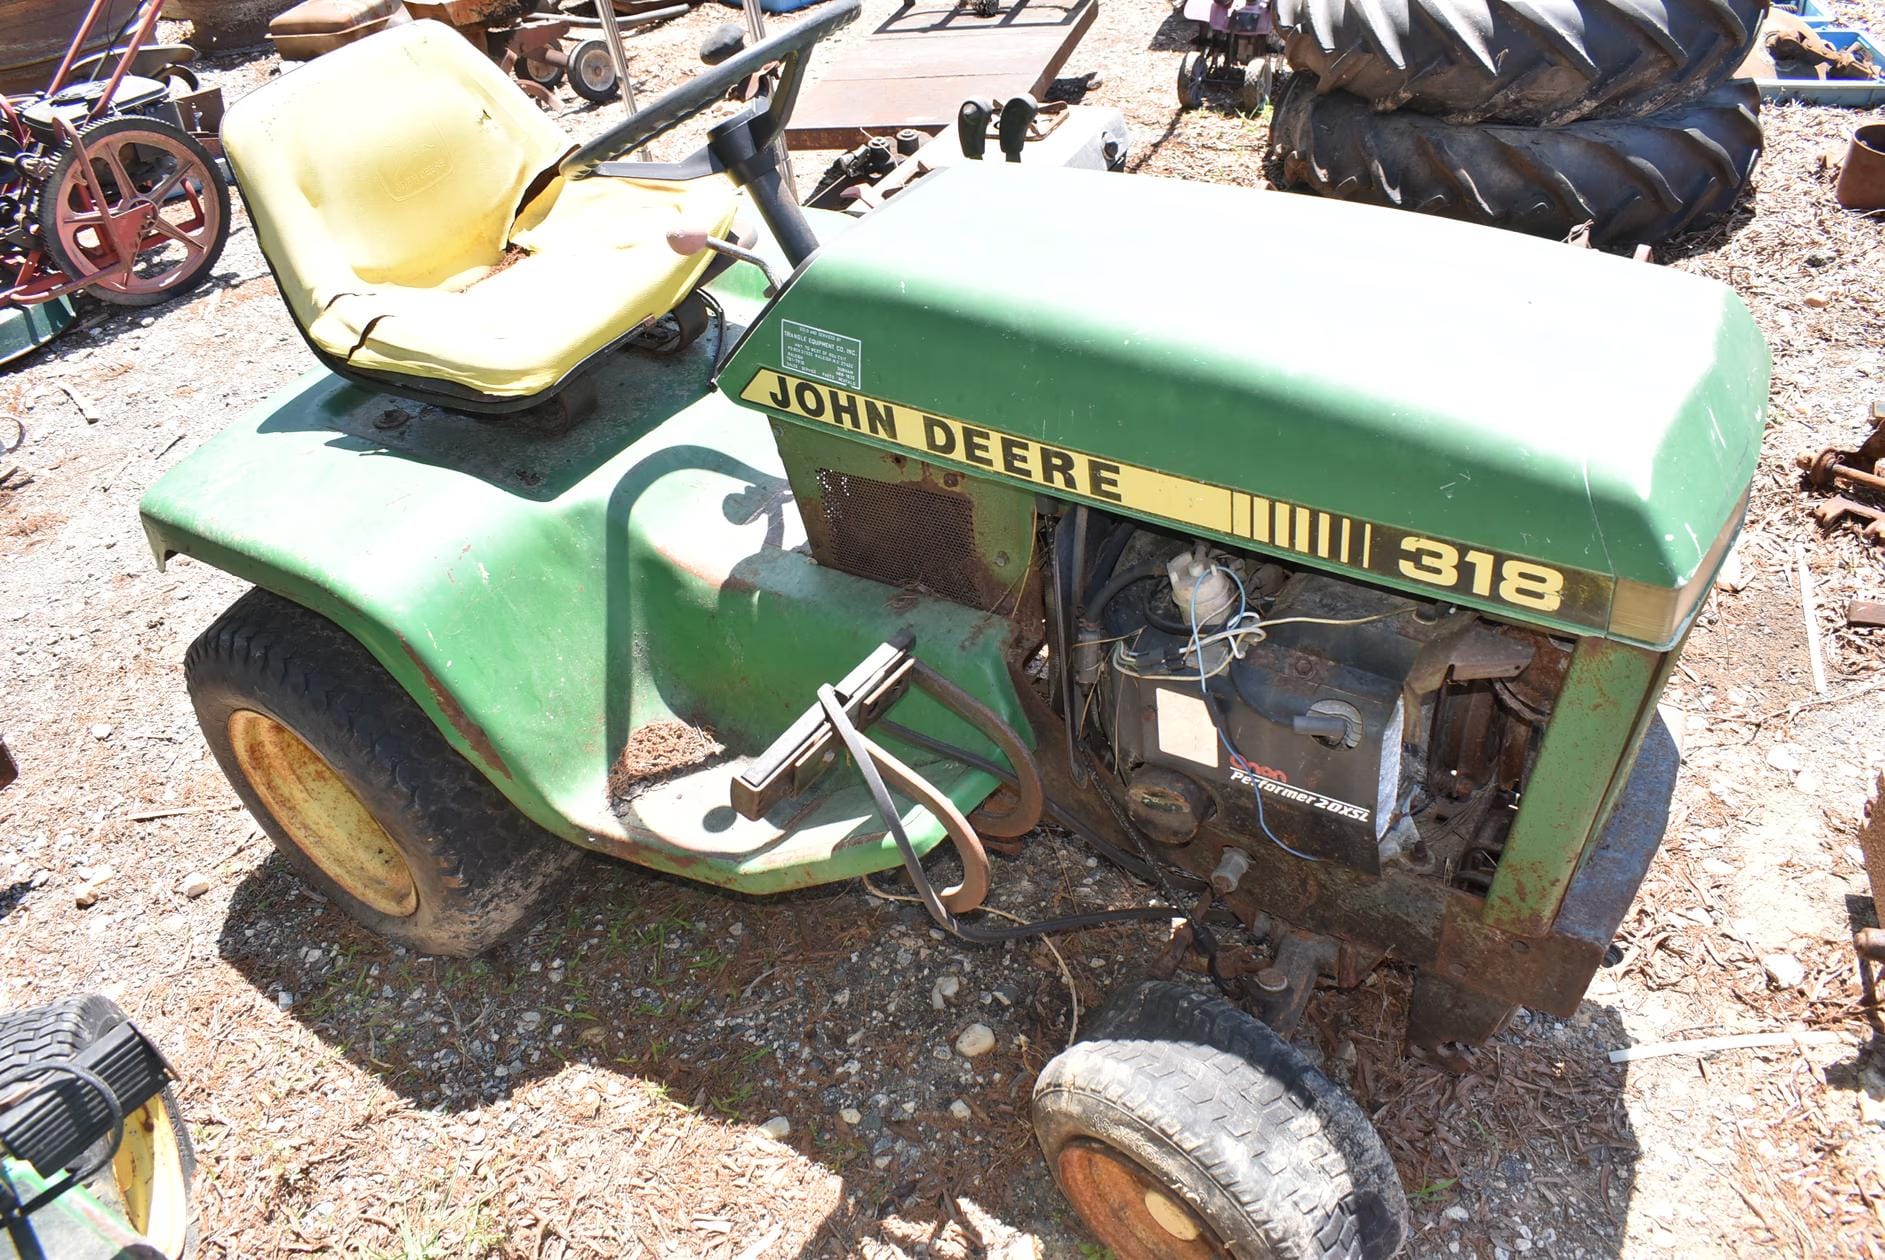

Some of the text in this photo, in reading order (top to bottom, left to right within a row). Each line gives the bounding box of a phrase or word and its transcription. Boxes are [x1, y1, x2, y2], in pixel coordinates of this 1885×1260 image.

[808, 337, 835, 350] EQUIPMENT
[769, 376, 1122, 502] JOHN DEERE
[1398, 536, 1564, 612] 318
[1313, 798, 1369, 823] 20XSL
